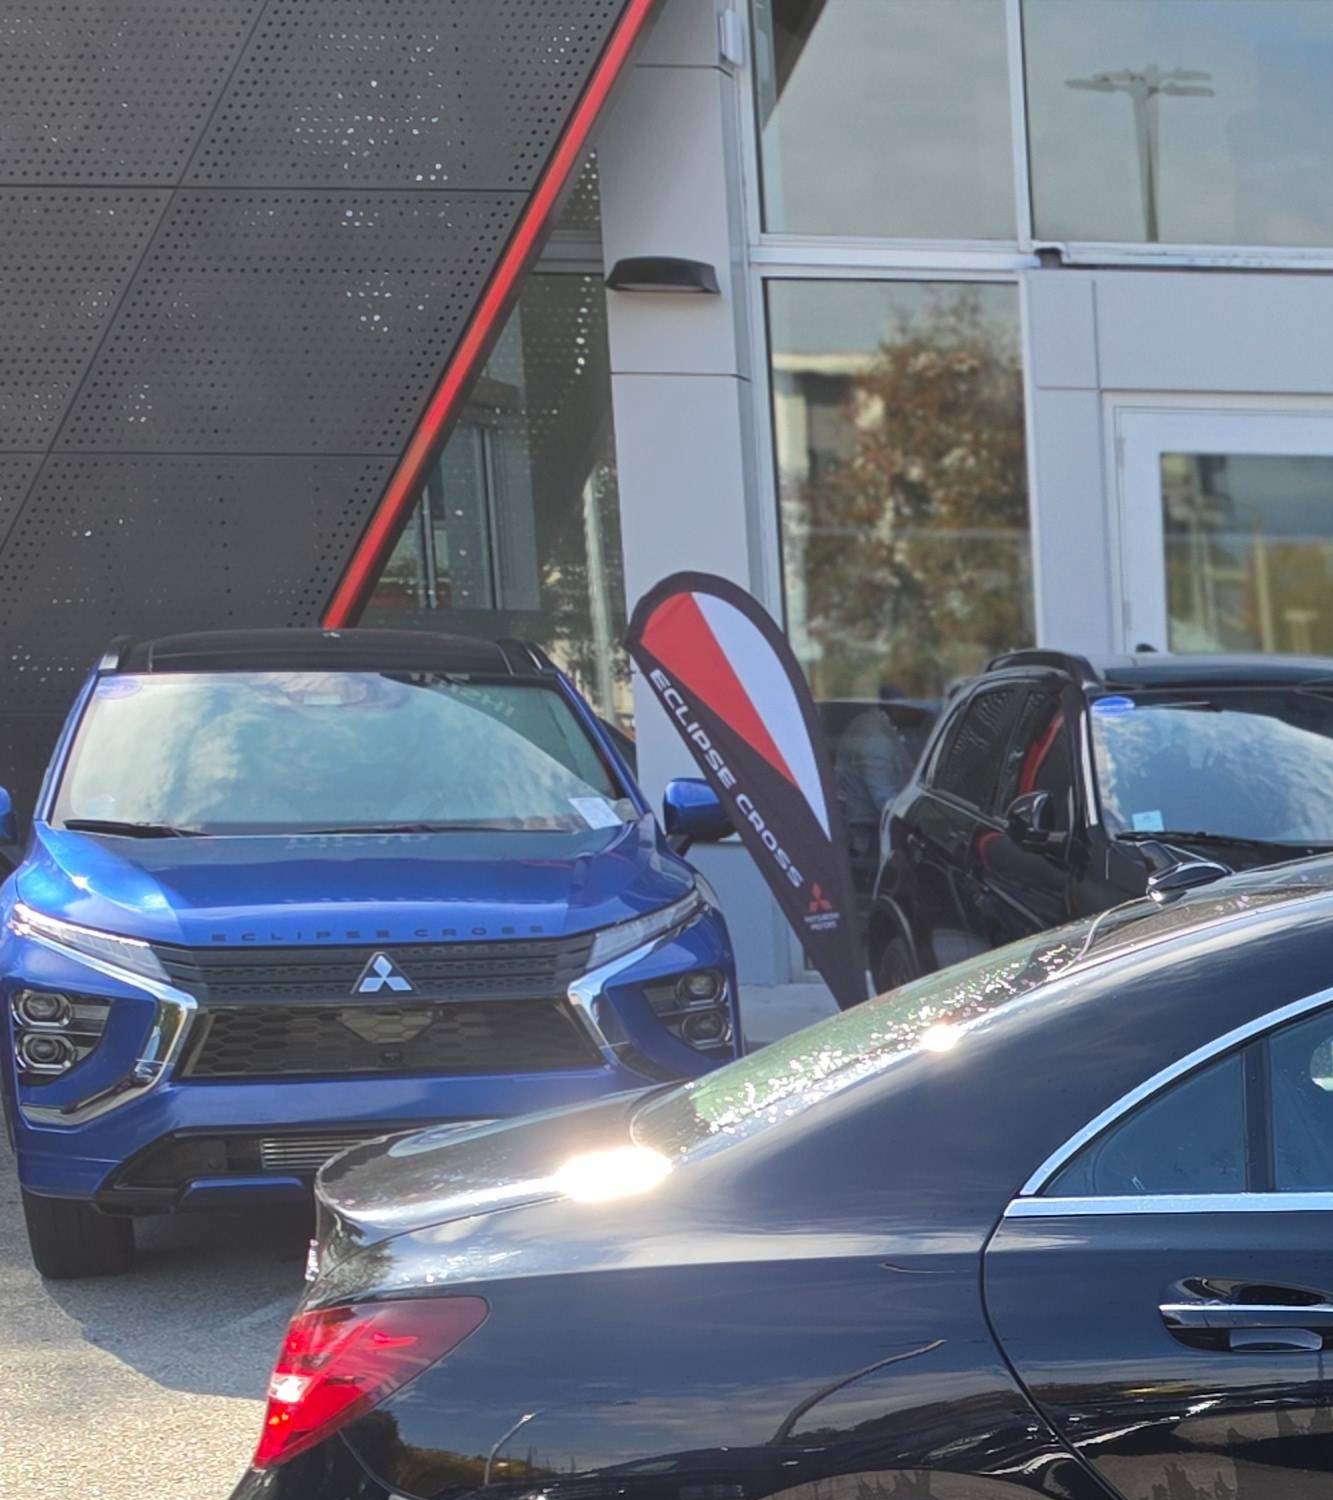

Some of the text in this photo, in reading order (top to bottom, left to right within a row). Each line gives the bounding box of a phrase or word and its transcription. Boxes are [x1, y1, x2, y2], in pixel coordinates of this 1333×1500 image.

[650, 668, 804, 887] ECLIPSE CROSS
[211, 925, 544, 942] ECLIPSE CROSS
